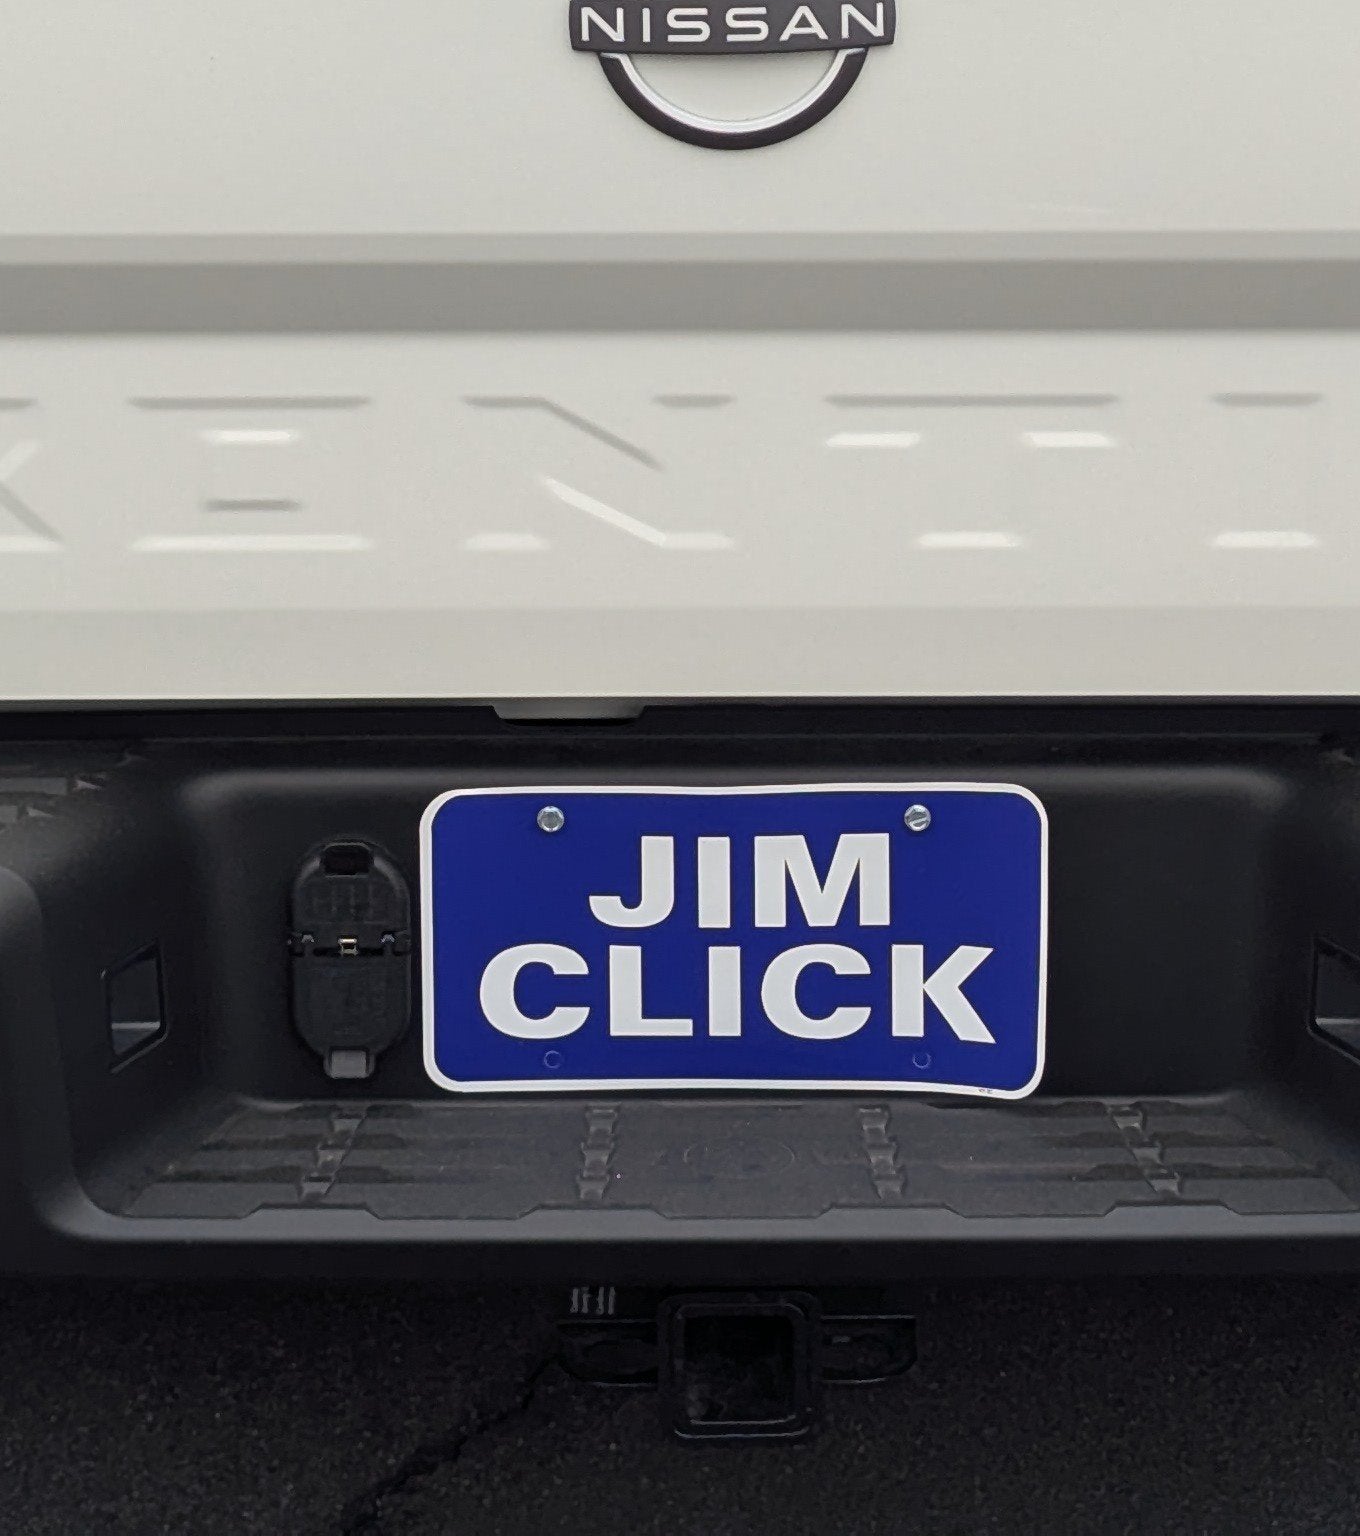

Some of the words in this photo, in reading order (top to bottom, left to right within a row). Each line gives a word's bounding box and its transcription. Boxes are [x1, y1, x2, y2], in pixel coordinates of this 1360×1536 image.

[579, 2, 886, 44] NISSAN
[588, 831, 891, 929] JIM
[478, 943, 997, 1045] CLICK
